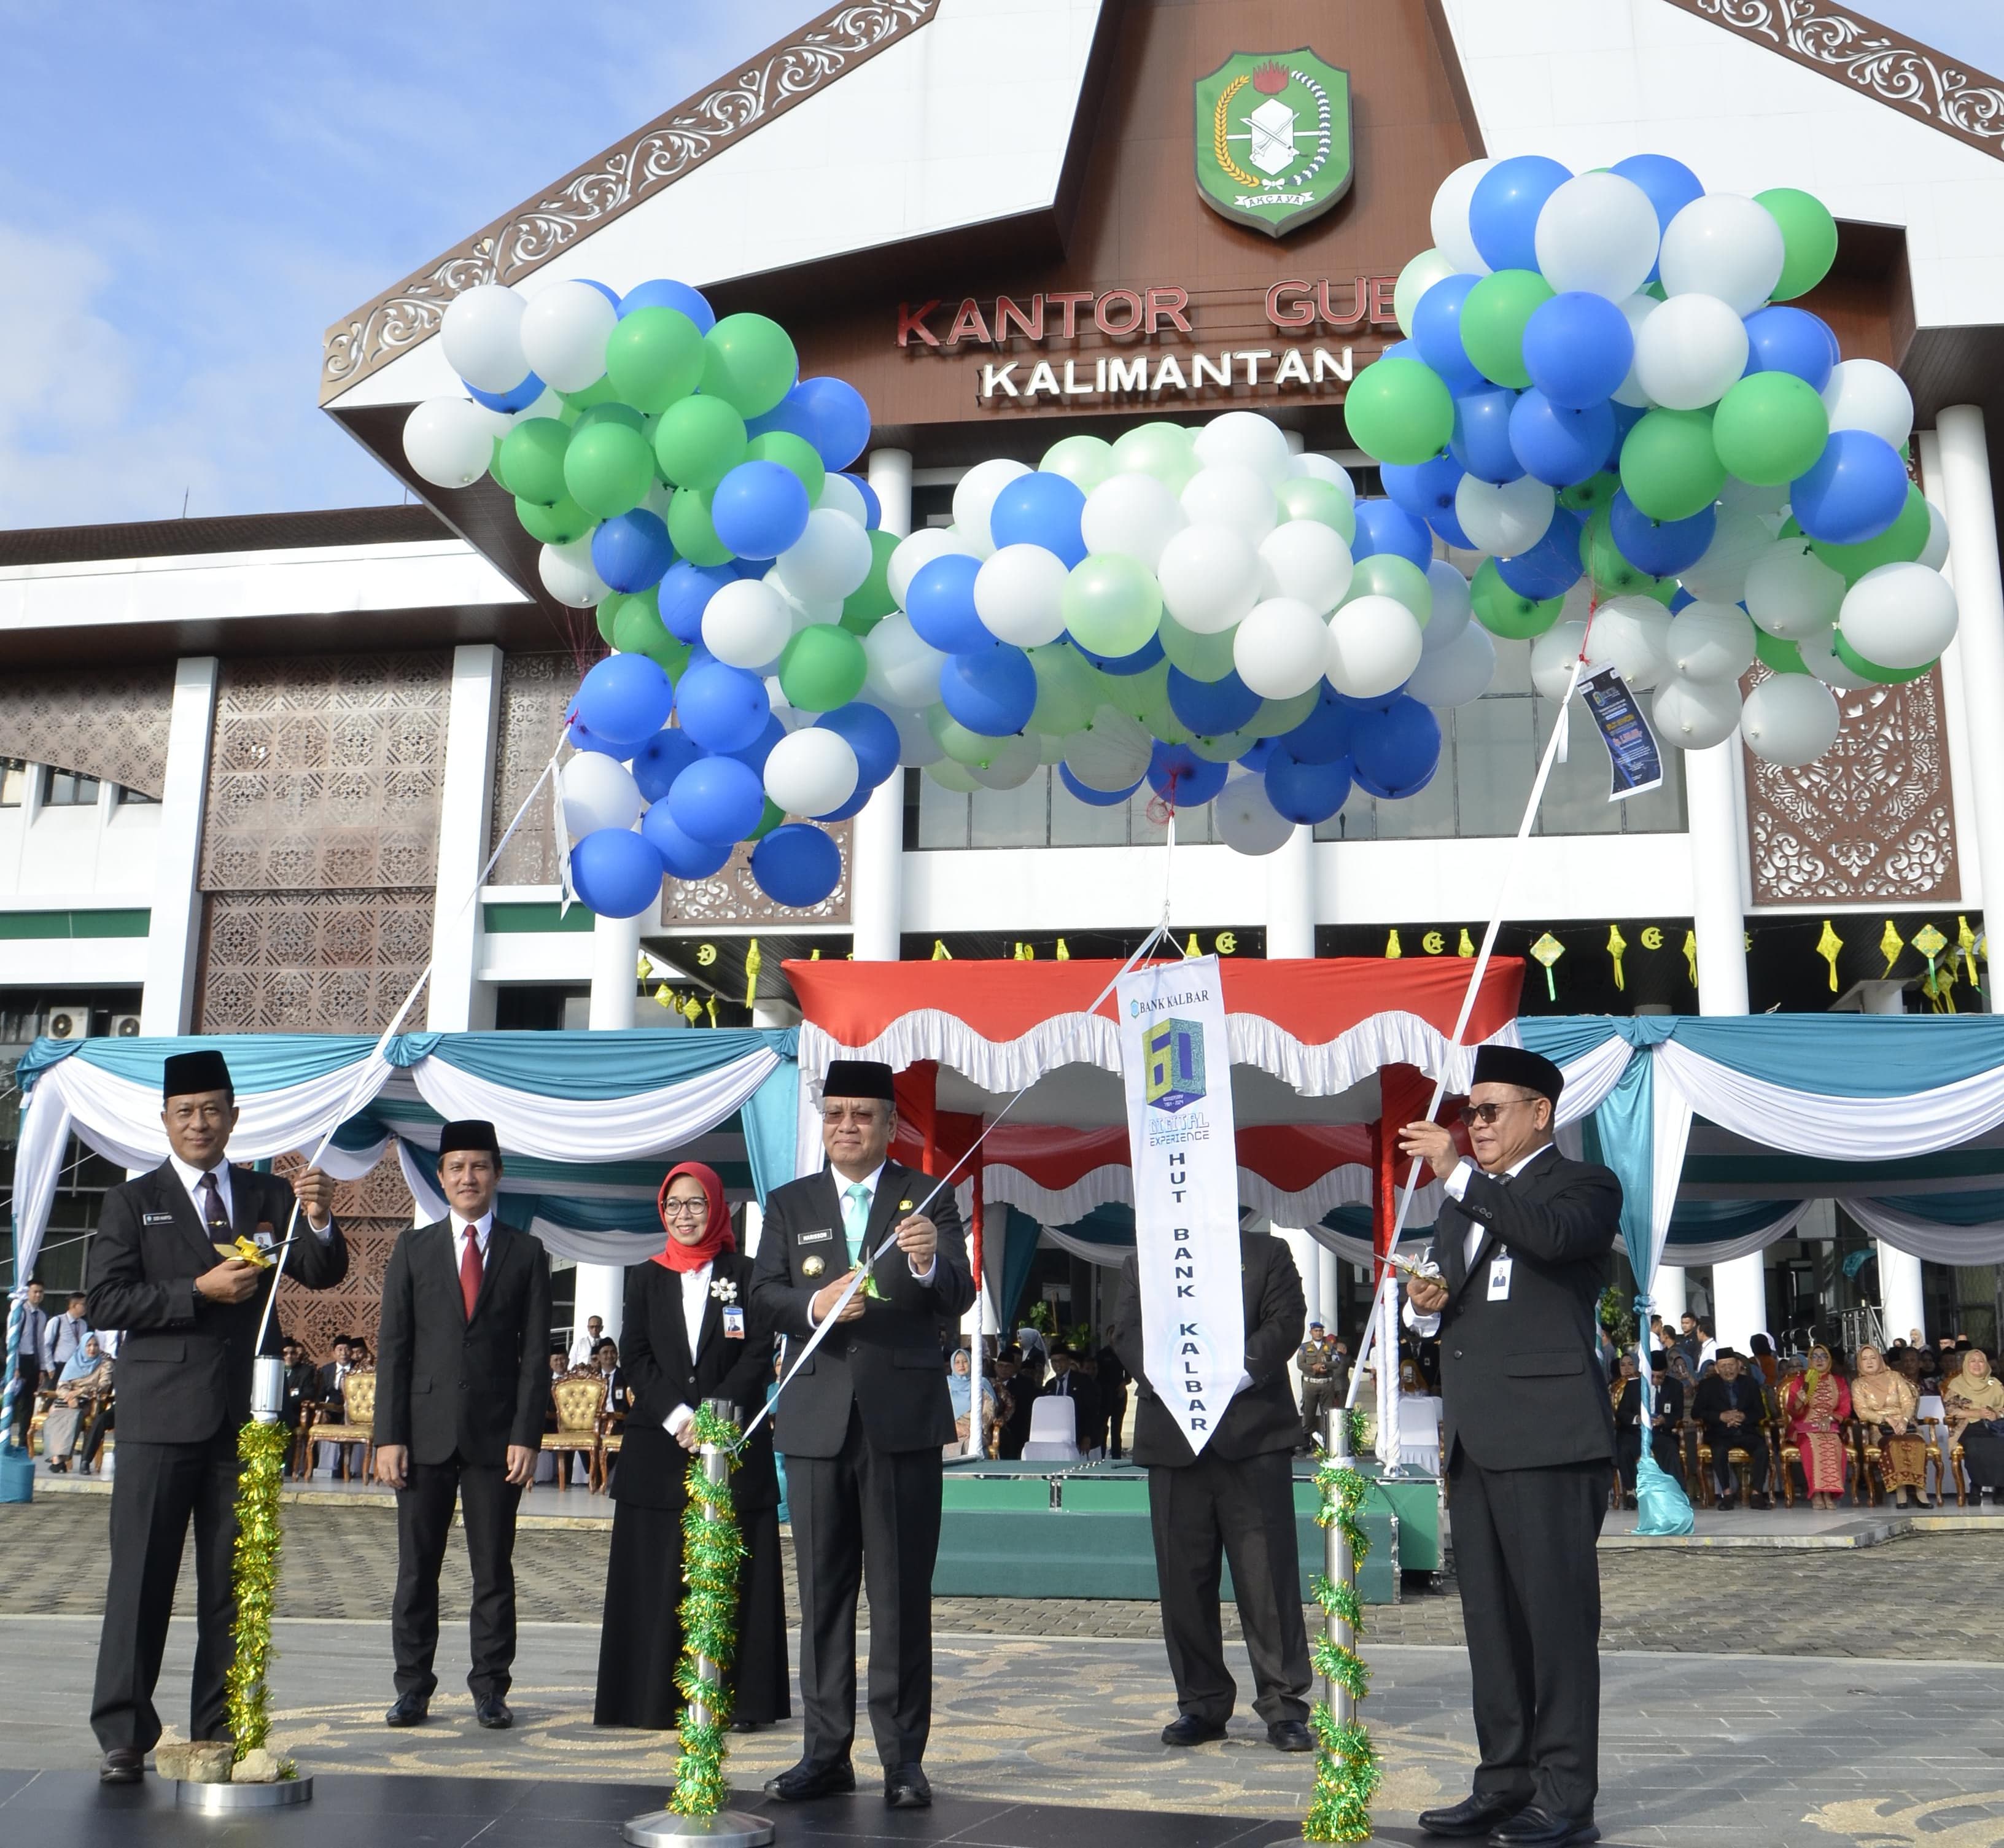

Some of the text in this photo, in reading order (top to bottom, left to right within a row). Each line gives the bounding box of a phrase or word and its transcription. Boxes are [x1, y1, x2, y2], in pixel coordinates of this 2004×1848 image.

[897, 285, 1192, 347] KANTOR
[983, 346, 1353, 398] KALIMANTAN
[1140, 990, 1209, 1013] BANK KALBAR
[1150, 1130, 1210, 1146] EXPERIENCE
[1169, 1152, 1208, 1431] HUT BANK KALBAR
